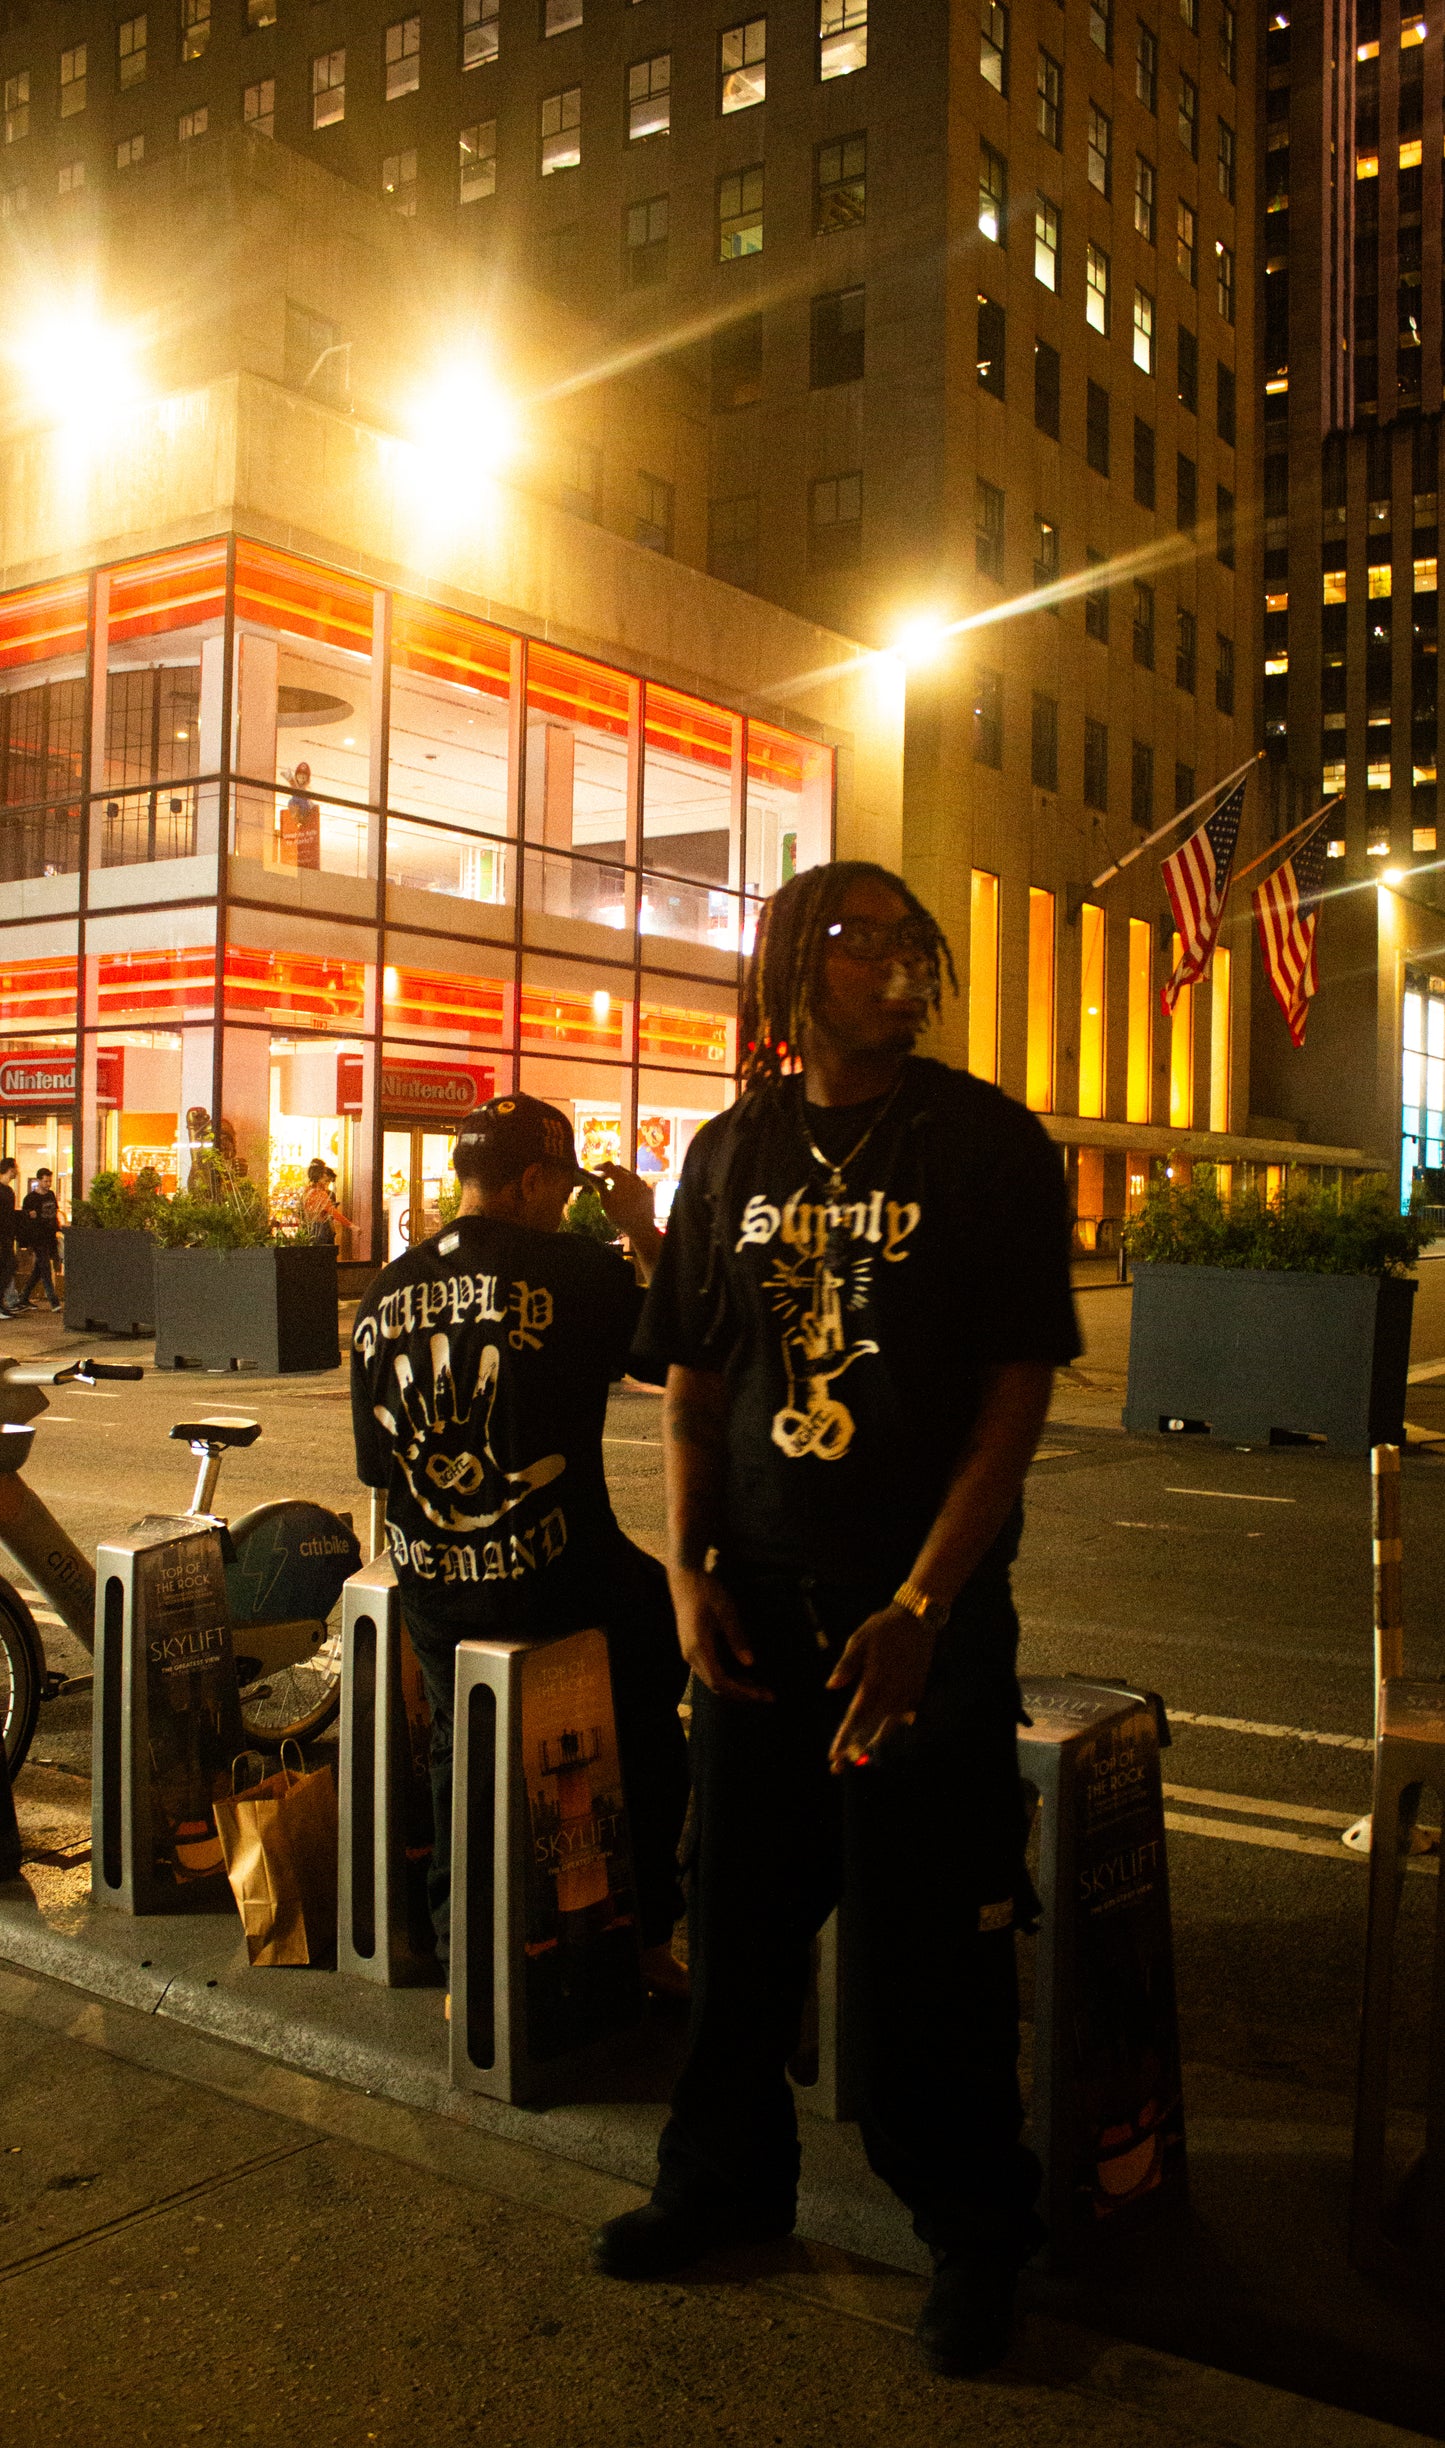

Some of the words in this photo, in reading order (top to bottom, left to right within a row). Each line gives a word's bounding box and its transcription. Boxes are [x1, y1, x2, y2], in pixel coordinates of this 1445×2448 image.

[6, 1068, 76, 1090] Nintend
[382, 1072, 469, 1101] Nintendo
[155, 1582, 174, 1595] THE
[177, 1573, 211, 1591] ROCK
[160, 1566, 182, 1581] TOP
[186, 1563, 203, 1575] OF
[150, 1626, 226, 1662] SKYLIFT
[1093, 1757, 1117, 1778] TOP
[1119, 1749, 1136, 1768] OF
[1087, 1777, 1107, 1800] THE
[1110, 1765, 1146, 1791] ROCK
[536, 1814, 619, 1862] SKYLIFT
[1079, 1840, 1159, 1900] SKYLIFT
